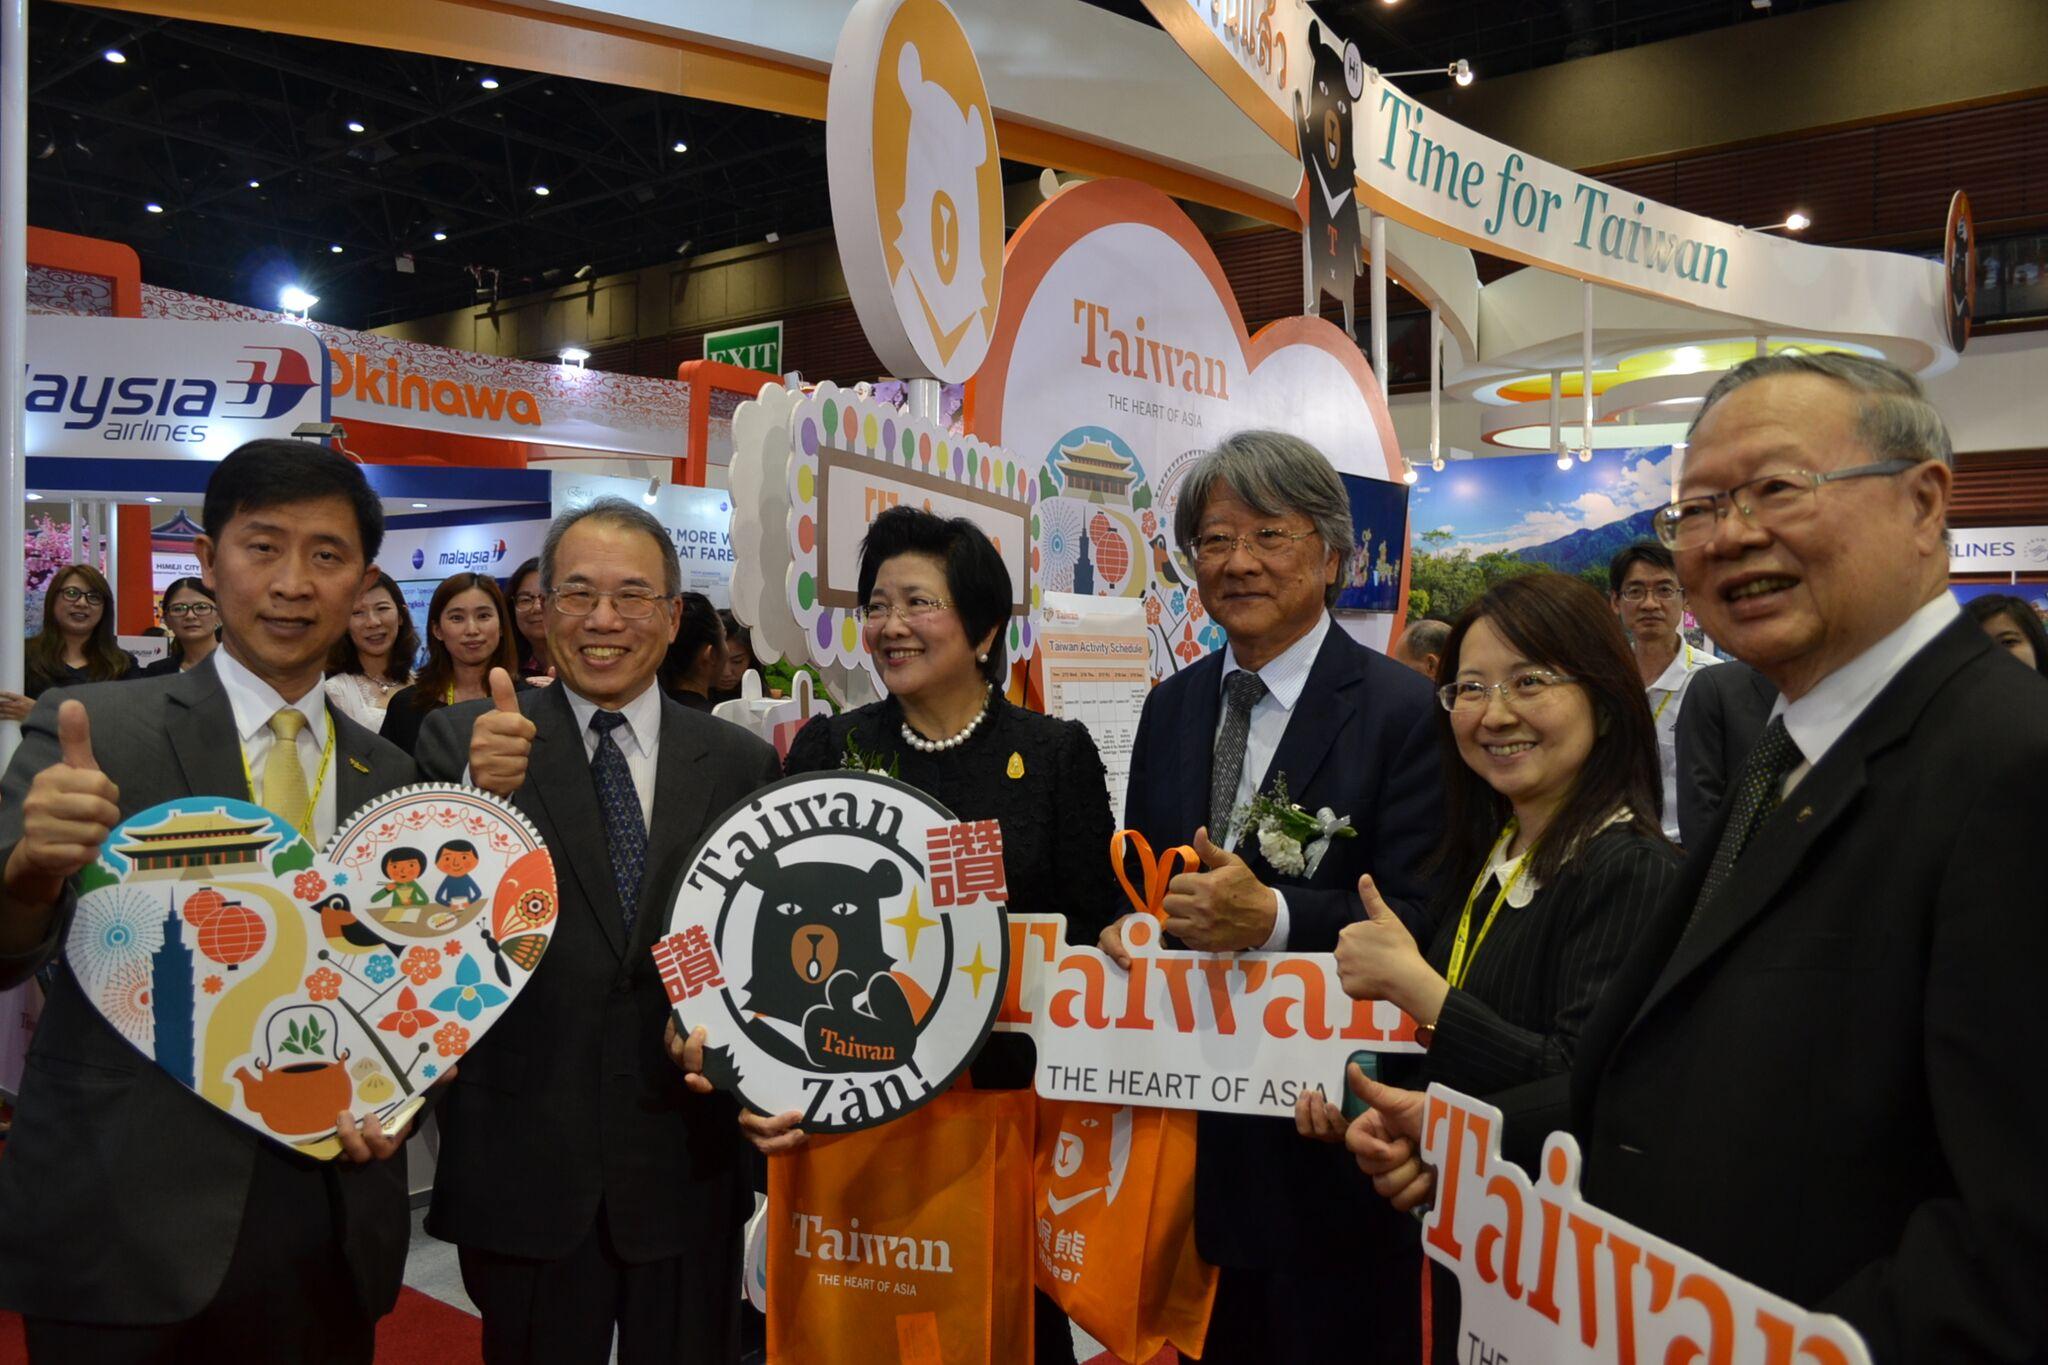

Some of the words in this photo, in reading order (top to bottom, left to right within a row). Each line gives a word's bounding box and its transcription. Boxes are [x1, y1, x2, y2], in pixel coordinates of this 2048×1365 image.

[1348, 57, 1359, 82] Hi
[1379, 88, 1485, 209] Time
[1484, 153, 1562, 235] for
[1573, 182, 1730, 289] Taiwan
[1073, 298, 1230, 401] Taiwan
[25, 363, 217, 430] aysia
[1108, 393, 1129, 412] THE
[1131, 398, 1165, 421] HEART
[1167, 407, 1179, 423] OF
[1181, 411, 1203, 429] ASIA
[103, 419, 208, 443] airlines
[676, 529, 717, 545] MORE
[438, 549, 490, 569] malaysia
[1048, 640, 1079, 653] Taiwan
[1080, 641, 1109, 656] Activity
[1110, 643, 1143, 654] Schedule
[686, 791, 904, 898] Taiwan
[820, 1027, 896, 1061] Taiwan
[1047, 1065, 1098, 1092] THE
[1108, 1070, 1201, 1099] HEART
[1211, 1076, 1250, 1102] OF
[791, 1211, 953, 1274] Taiwan
[817, 1273, 841, 1287] THE
[843, 1276, 875, 1291] HEART
[877, 1281, 891, 1293] OF
[893, 1283, 917, 1297] ASIA
